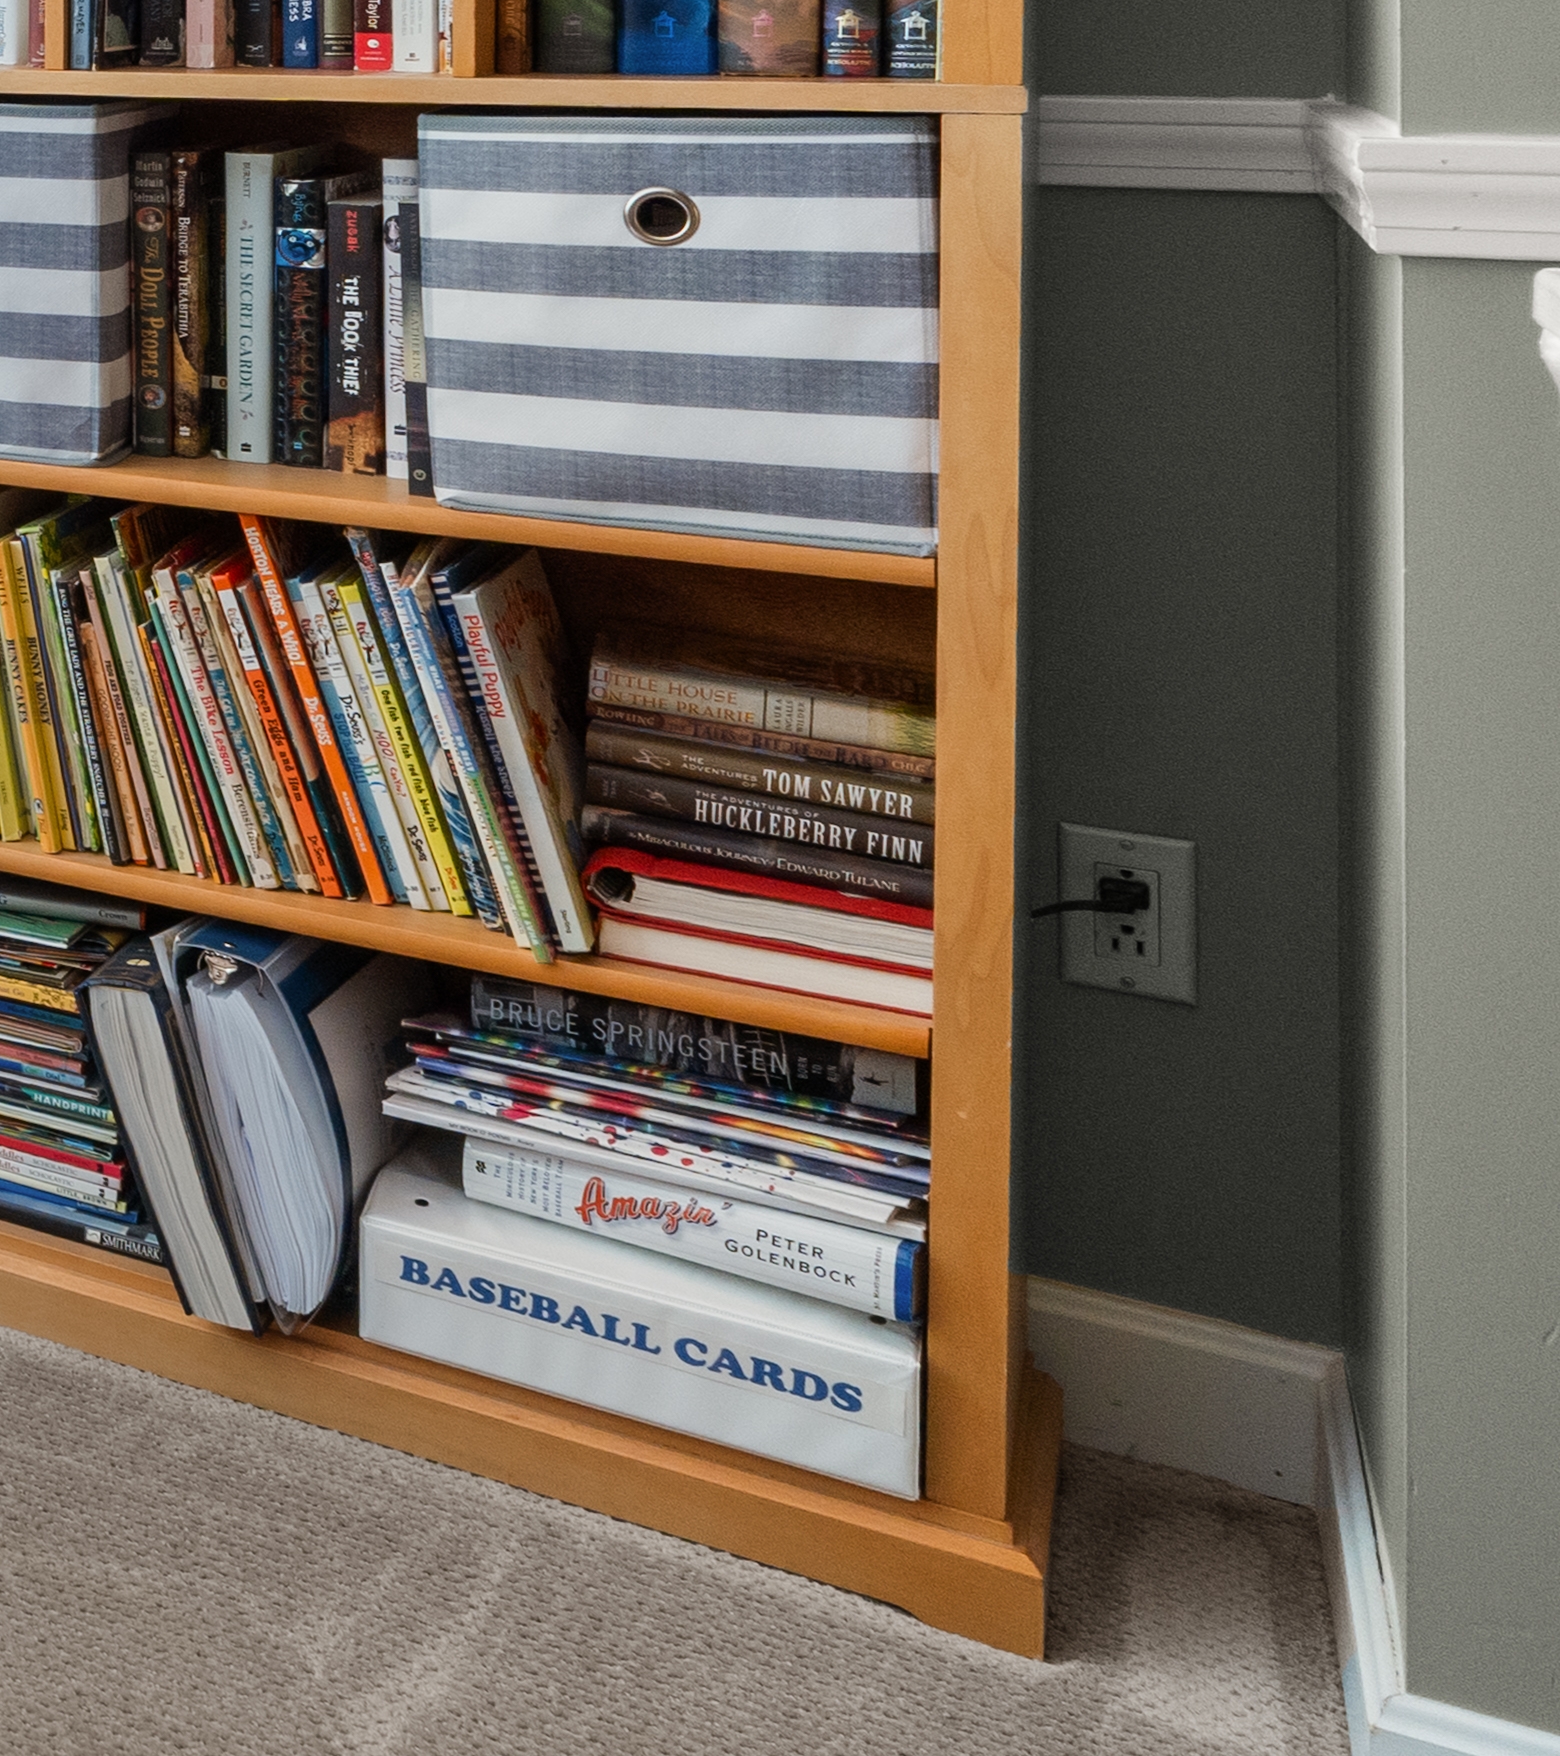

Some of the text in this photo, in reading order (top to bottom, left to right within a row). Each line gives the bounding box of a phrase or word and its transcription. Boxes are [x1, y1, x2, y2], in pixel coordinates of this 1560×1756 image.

[178, 216, 191, 257] BRIDGE
[139, 267, 165, 378] DOLL PEOPLE
[240, 236, 254, 403] THE SECRET GARDEN
[245, 526, 304, 668] HORTON HEARS WHO!
[6, 639, 29, 725] BUNNY CAKES
[27, 636, 51, 726] BUNNY MONEY
[464, 613, 506, 720] Playful Puppy
[592, 668, 738, 705] LITTLE HOUSE
[191, 666, 234, 775] The Bike Lesson
[310, 714, 332, 746] Seuss
[387, 703, 399, 722] fish
[677, 700, 755, 724] PRAIRIE
[253, 679, 303, 802] Green Eggs and Ham
[681, 763, 758, 782] ADVENTURES
[763, 768, 914, 819] TOM SAWYER
[695, 790, 799, 816] THE ADVENTURES
[694, 798, 923, 865] HUCKLEBERRY FINN
[777, 857, 901, 893] EDWARD TULANE
[489, 996, 788, 1076] BRUCE SPRINGSTEEN
[33, 1094, 108, 1119] HANDPRINT
[102, 1232, 161, 1262] SMITHMARK
[724, 1238, 858, 1289] GOLENBOCK
[755, 1226, 825, 1260] PETER
[399, 1254, 864, 1414] BASEBALL CARDS
